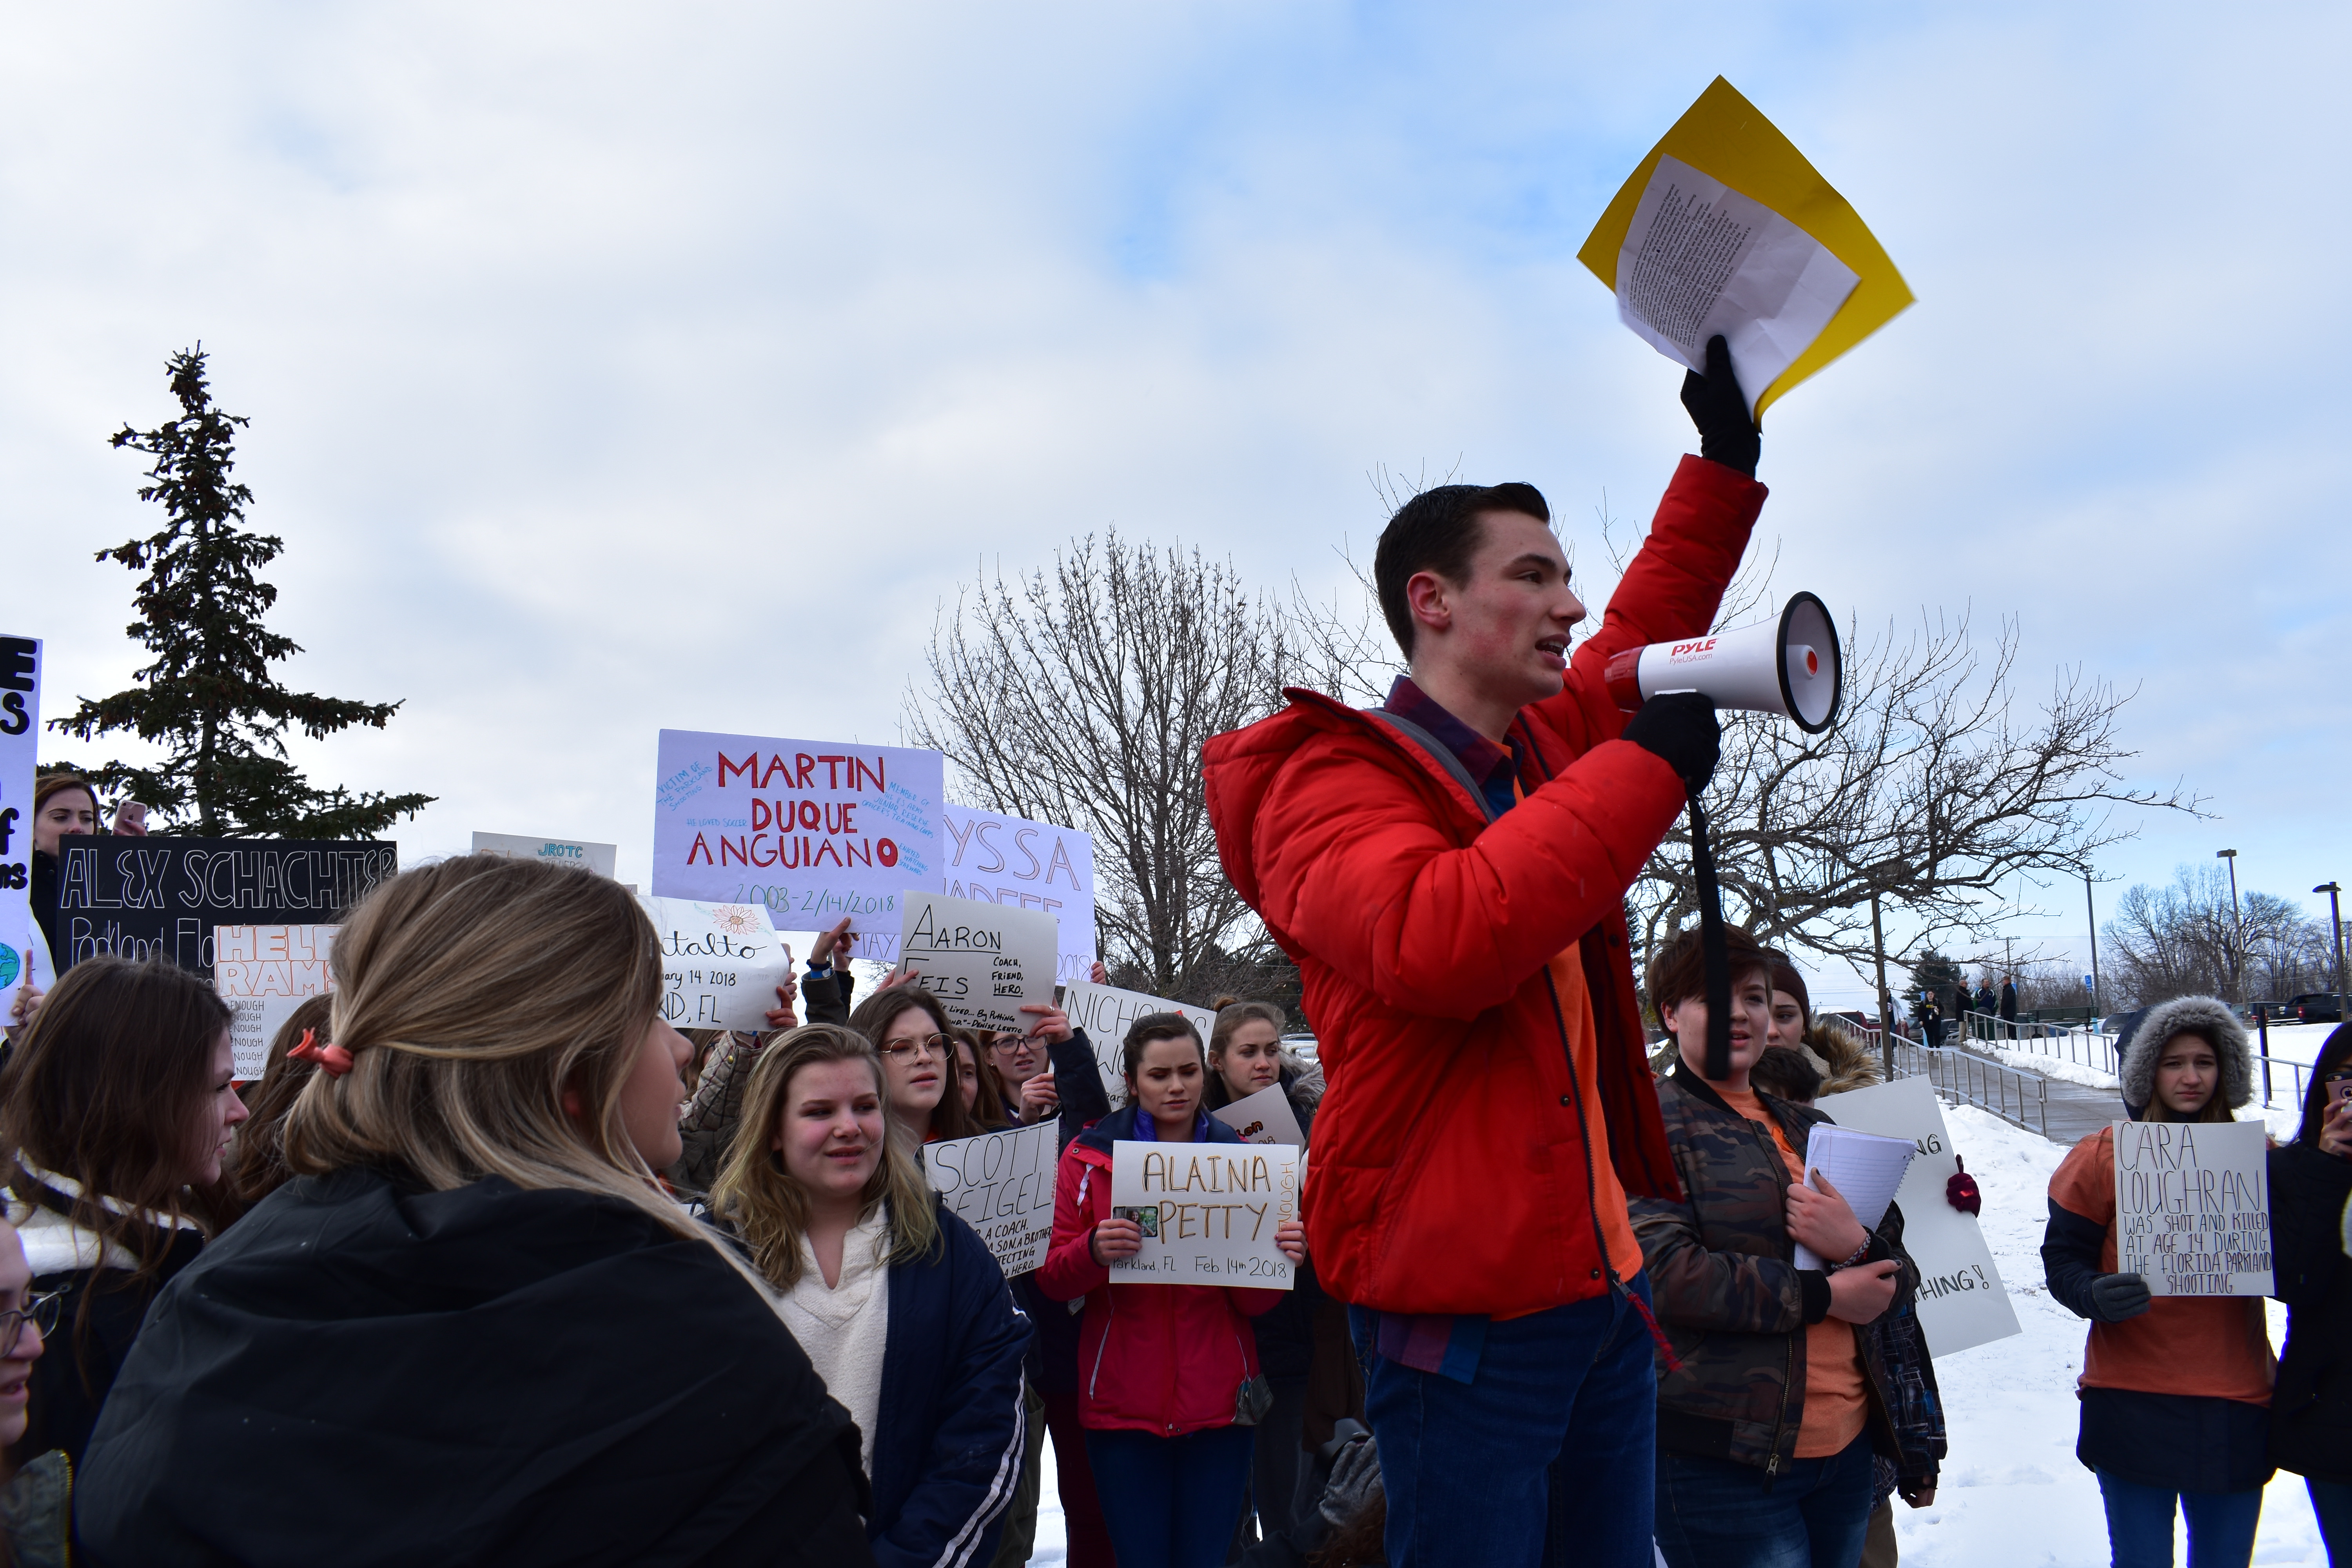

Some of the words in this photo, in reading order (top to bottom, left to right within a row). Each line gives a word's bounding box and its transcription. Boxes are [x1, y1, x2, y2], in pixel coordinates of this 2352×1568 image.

[1670, 653, 1712, 666] PyleUSA.com
[1671, 639, 1717, 657] PYLE
[657, 770, 690, 793] VICTIM
[718, 751, 885, 793] MARTIN
[657, 793, 674, 806] THE
[675, 766, 712, 793] PARKLAND
[669, 785, 702, 811] SHOOTING
[888, 782, 917, 801] MEMBER
[874, 797, 898, 815] JUNIOR
[902, 809, 930, 827] RESERVE
[884, 791, 893, 800] THE
[907, 803, 924, 815] ARMY
[723, 818, 747, 827] SOCCER
[752, 798, 857, 835] DUQUE
[892, 813, 919, 831] TRAINING
[920, 827, 933, 838] CORPS
[538, 843, 583, 858] JROTC
[686, 831, 898, 869] ANGUIANO
[898, 843, 920, 859] ENJOYED
[944, 814, 1081, 891] YSSA
[904, 855, 929, 871] WATCHING
[60, 848, 171, 909] ALEX
[906, 904, 1002, 950] AARON
[660, 930, 768, 959] talto
[993, 956, 1021, 968] COACH,
[690, 969, 702, 984] 14
[710, 971, 736, 986] 2018
[994, 983, 1024, 995] HERO.
[234, 1013, 261, 1022] NOUGH
[658, 991, 691, 1024] ND,
[699, 995, 721, 1023] FL
[977, 1009, 987, 1022] By
[234, 1051, 263, 1062] NOUGH
[936, 1122, 1054, 1194] SCOTT
[1913, 1134, 1942, 1160] NG
[2118, 1122, 2196, 1171] CARA
[1142, 1151, 1271, 1193] ALAINA
[942, 1172, 1051, 1223] EIGEL
[2120, 1170, 2260, 1214] LOUGHRAN
[985, 1227, 992, 1240] A
[995, 1218, 1029, 1238] COACH.
[1158, 1200, 1268, 1244] PETTY
[2124, 1216, 2152, 1236] WAS
[2165, 1214, 2195, 1233] SHOT
[2200, 1214, 2225, 1232] AND
[2232, 1212, 2270, 1231] KILLED
[2126, 1236, 2144, 1254] AT
[2152, 1234, 2177, 1254] AGE
[2188, 1234, 2203, 1254] 14
[2214, 1230, 2267, 1253] DURING
[996, 1245, 1035, 1265] TECTING
[1113, 1257, 1160, 1274] Parkland,
[1163, 1256, 1177, 1272] FL
[1195, 1256, 1222, 1273] Feb.
[1227, 1257, 1246, 1274] 14th
[1249, 1256, 1287, 1278] 2018
[2125, 1254, 2149, 1276] THE
[2161, 1253, 2220, 1274] FLORIDA
[2225, 1252, 2272, 1273] PARKLAND
[1011, 1259, 1034, 1276] HERO.
[1915, 1265, 1990, 1303] HING!
